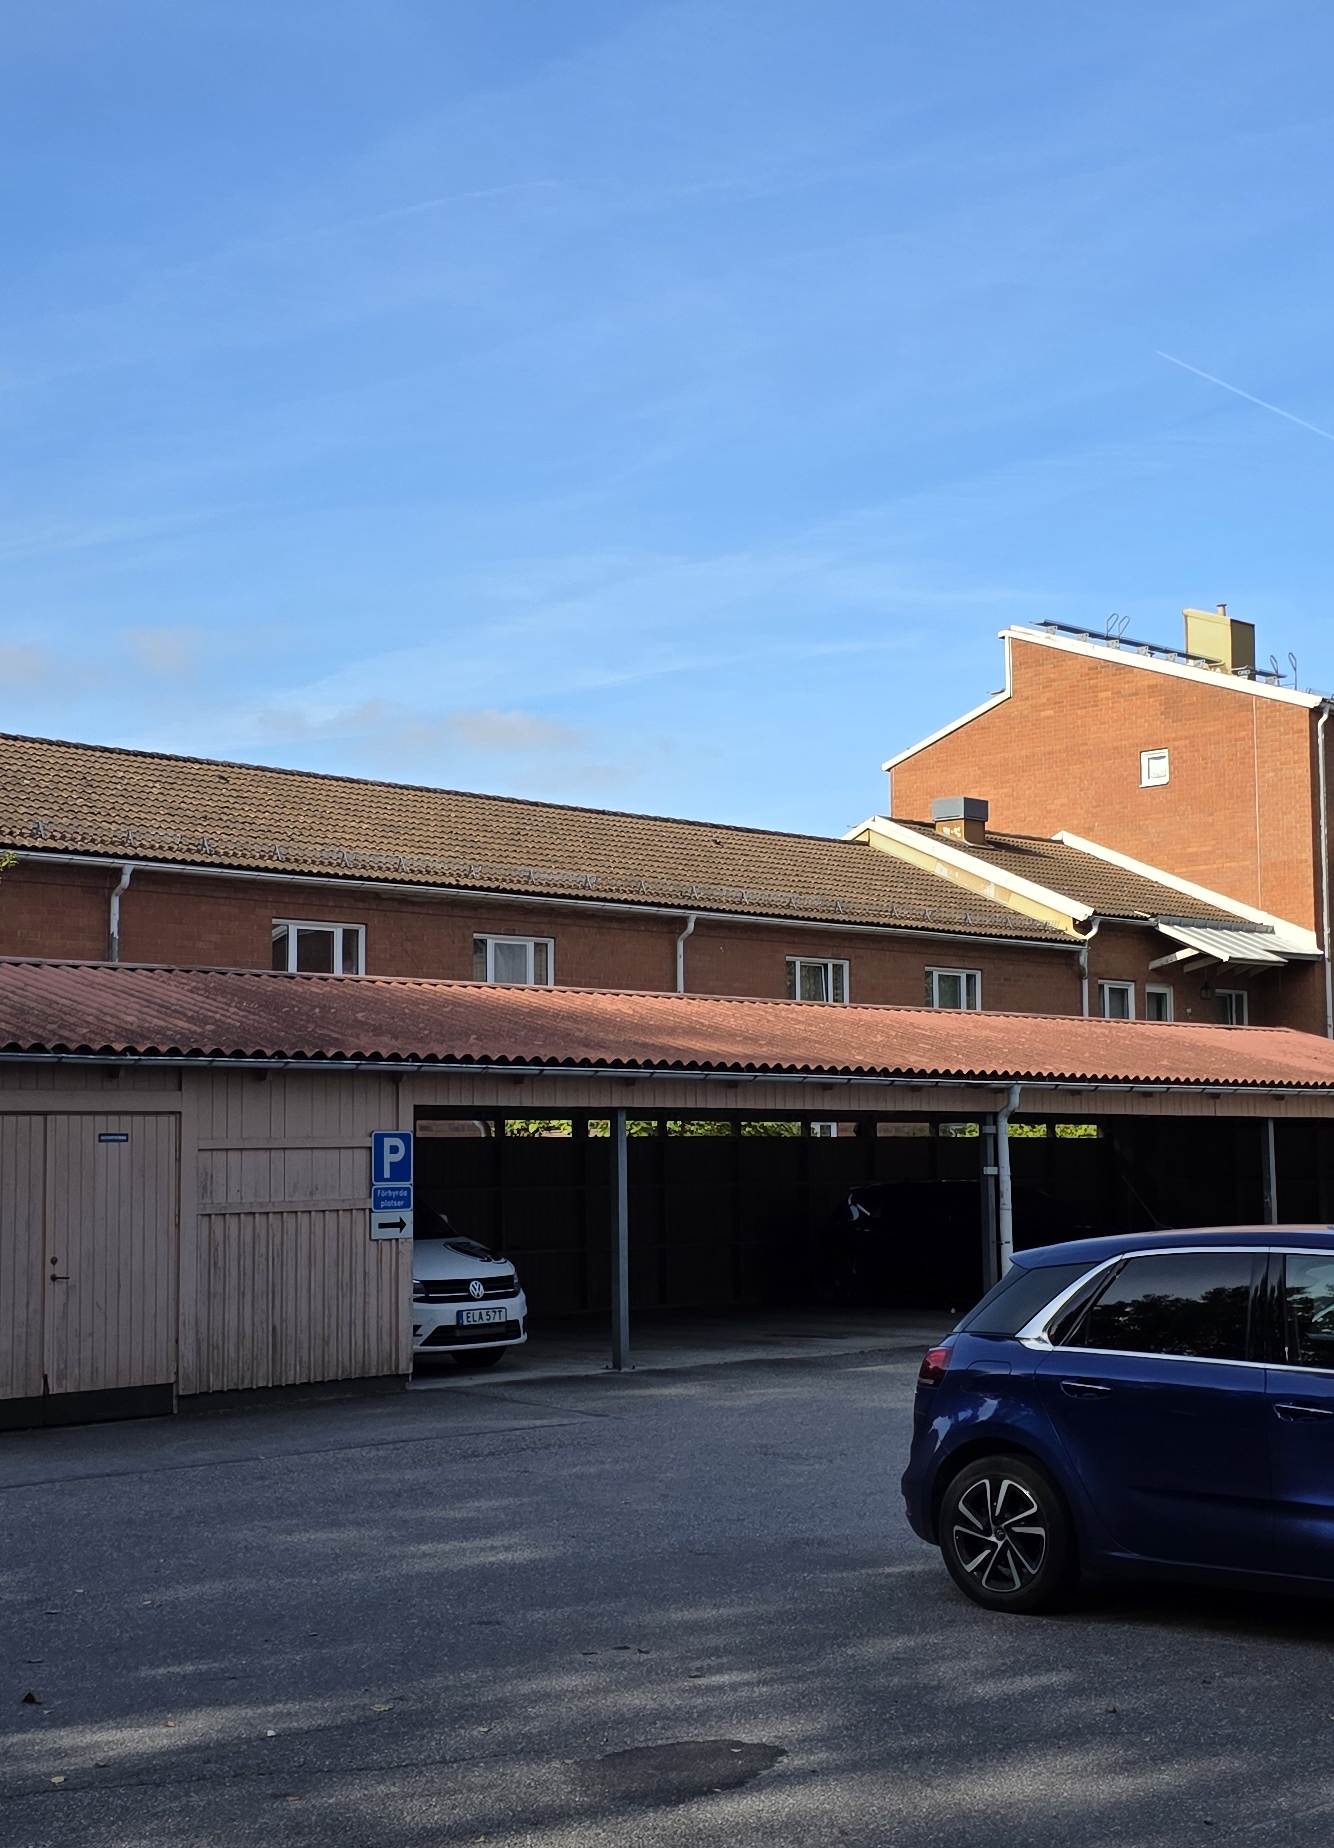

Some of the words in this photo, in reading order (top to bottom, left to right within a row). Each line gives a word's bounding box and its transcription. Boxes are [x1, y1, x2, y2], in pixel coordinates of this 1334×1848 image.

[383, 1137, 406, 1179] P
[377, 1189, 408, 1199] Förhyrda
[380, 1199, 405, 1209] platser
[466, 1311, 484, 1323] ELA
[486, 1310, 503, 1322] 57T
